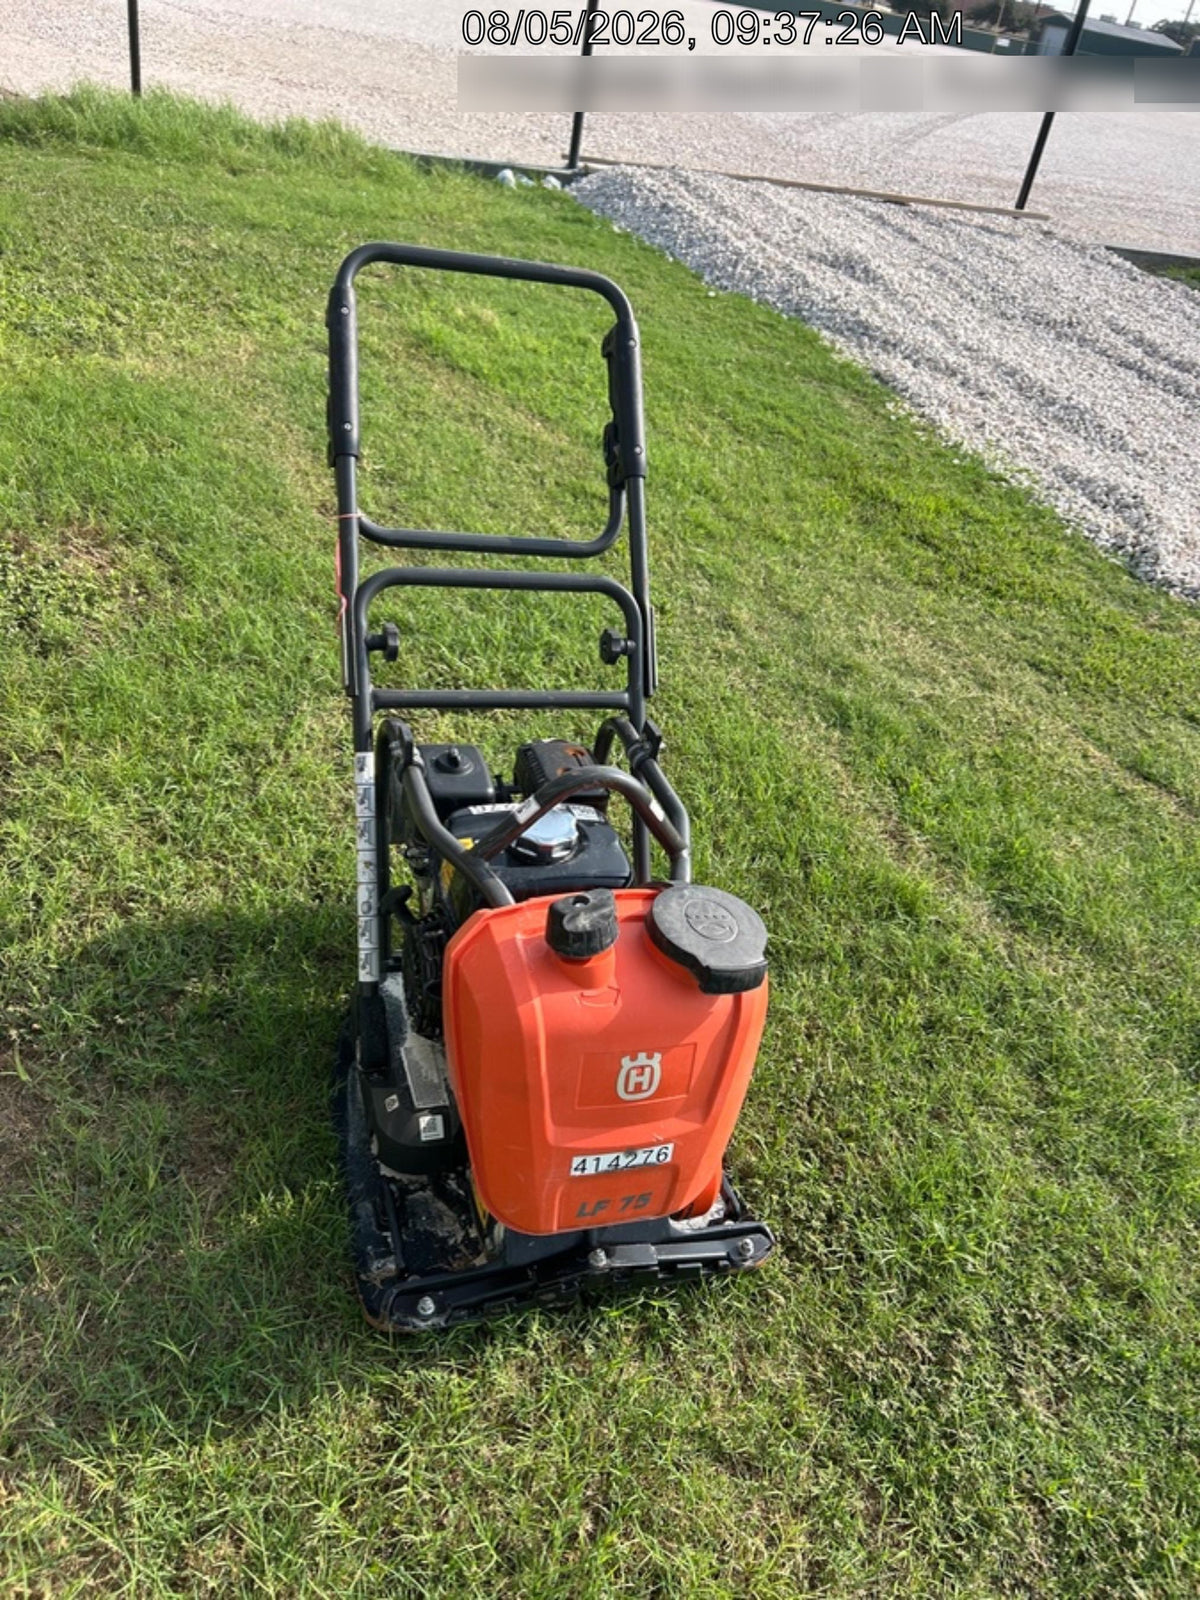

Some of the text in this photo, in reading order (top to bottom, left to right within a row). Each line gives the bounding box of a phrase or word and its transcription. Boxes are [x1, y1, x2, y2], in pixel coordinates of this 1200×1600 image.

[627, 1066, 650, 1092] H
[573, 1146, 669, 1174] 414276
[576, 1192, 651, 1219] LF 75
